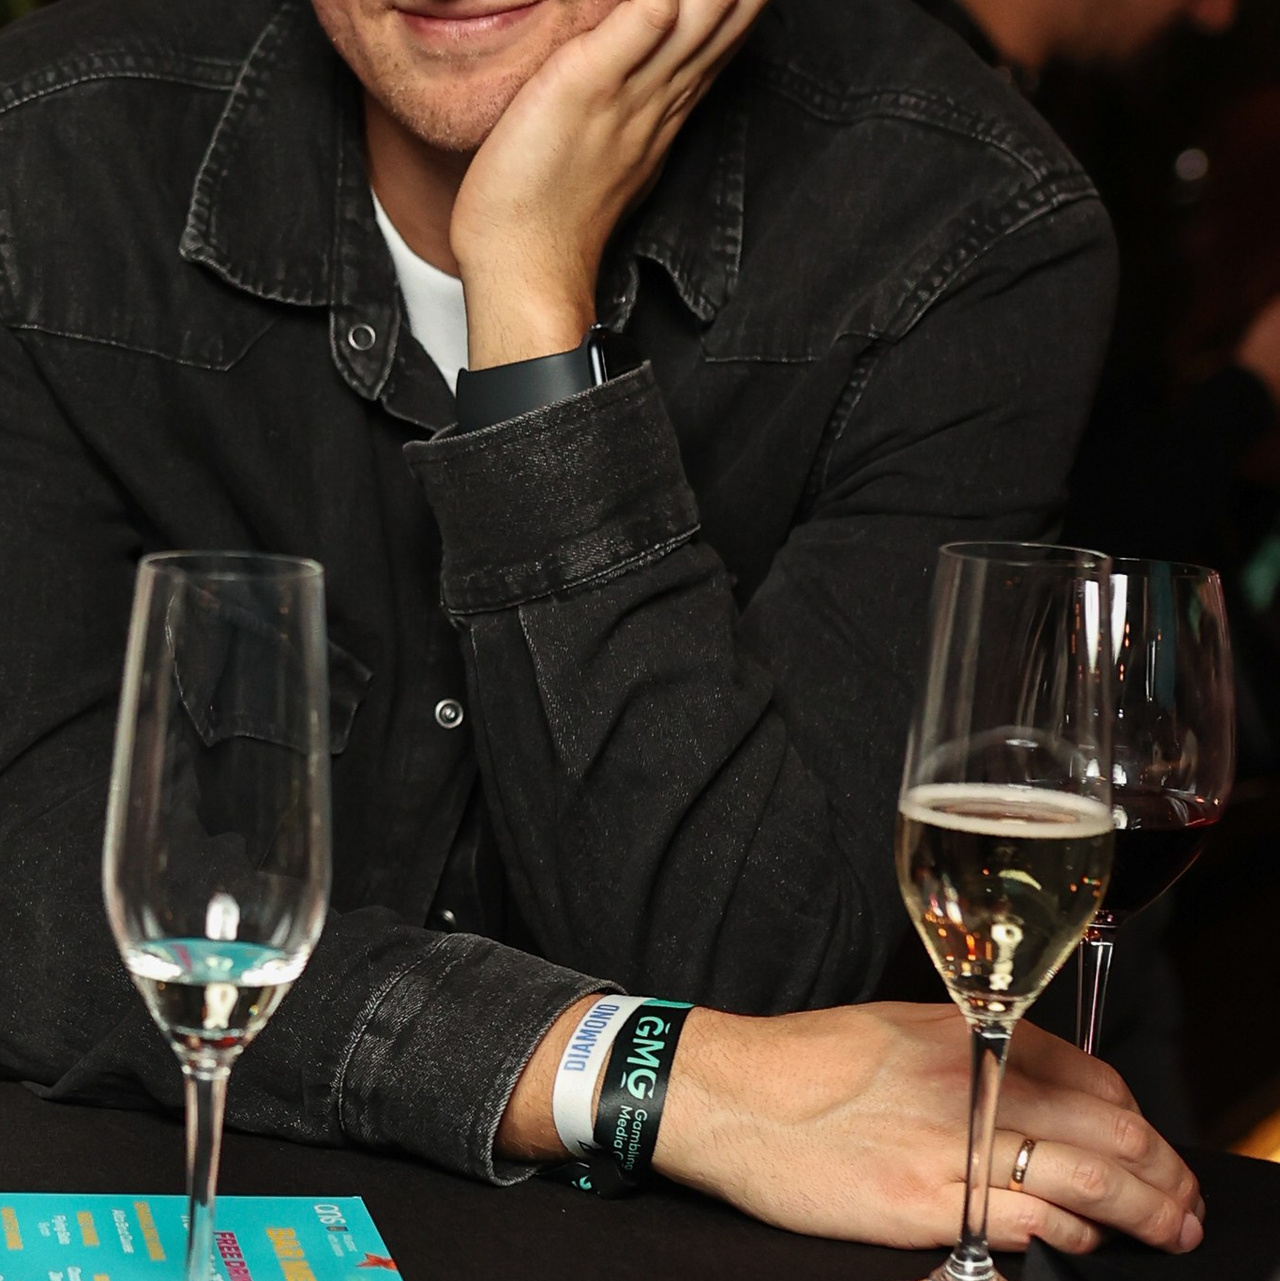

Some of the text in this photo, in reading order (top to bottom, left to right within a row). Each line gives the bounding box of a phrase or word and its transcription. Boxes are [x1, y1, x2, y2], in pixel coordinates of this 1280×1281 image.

[564, 1004, 620, 1072] DIAMOND
[621, 1016, 671, 1100] GMG
[614, 1105, 633, 1149] Media
[625, 1109, 648, 1171] Gambling
[213, 1231, 243, 1259] FREE
